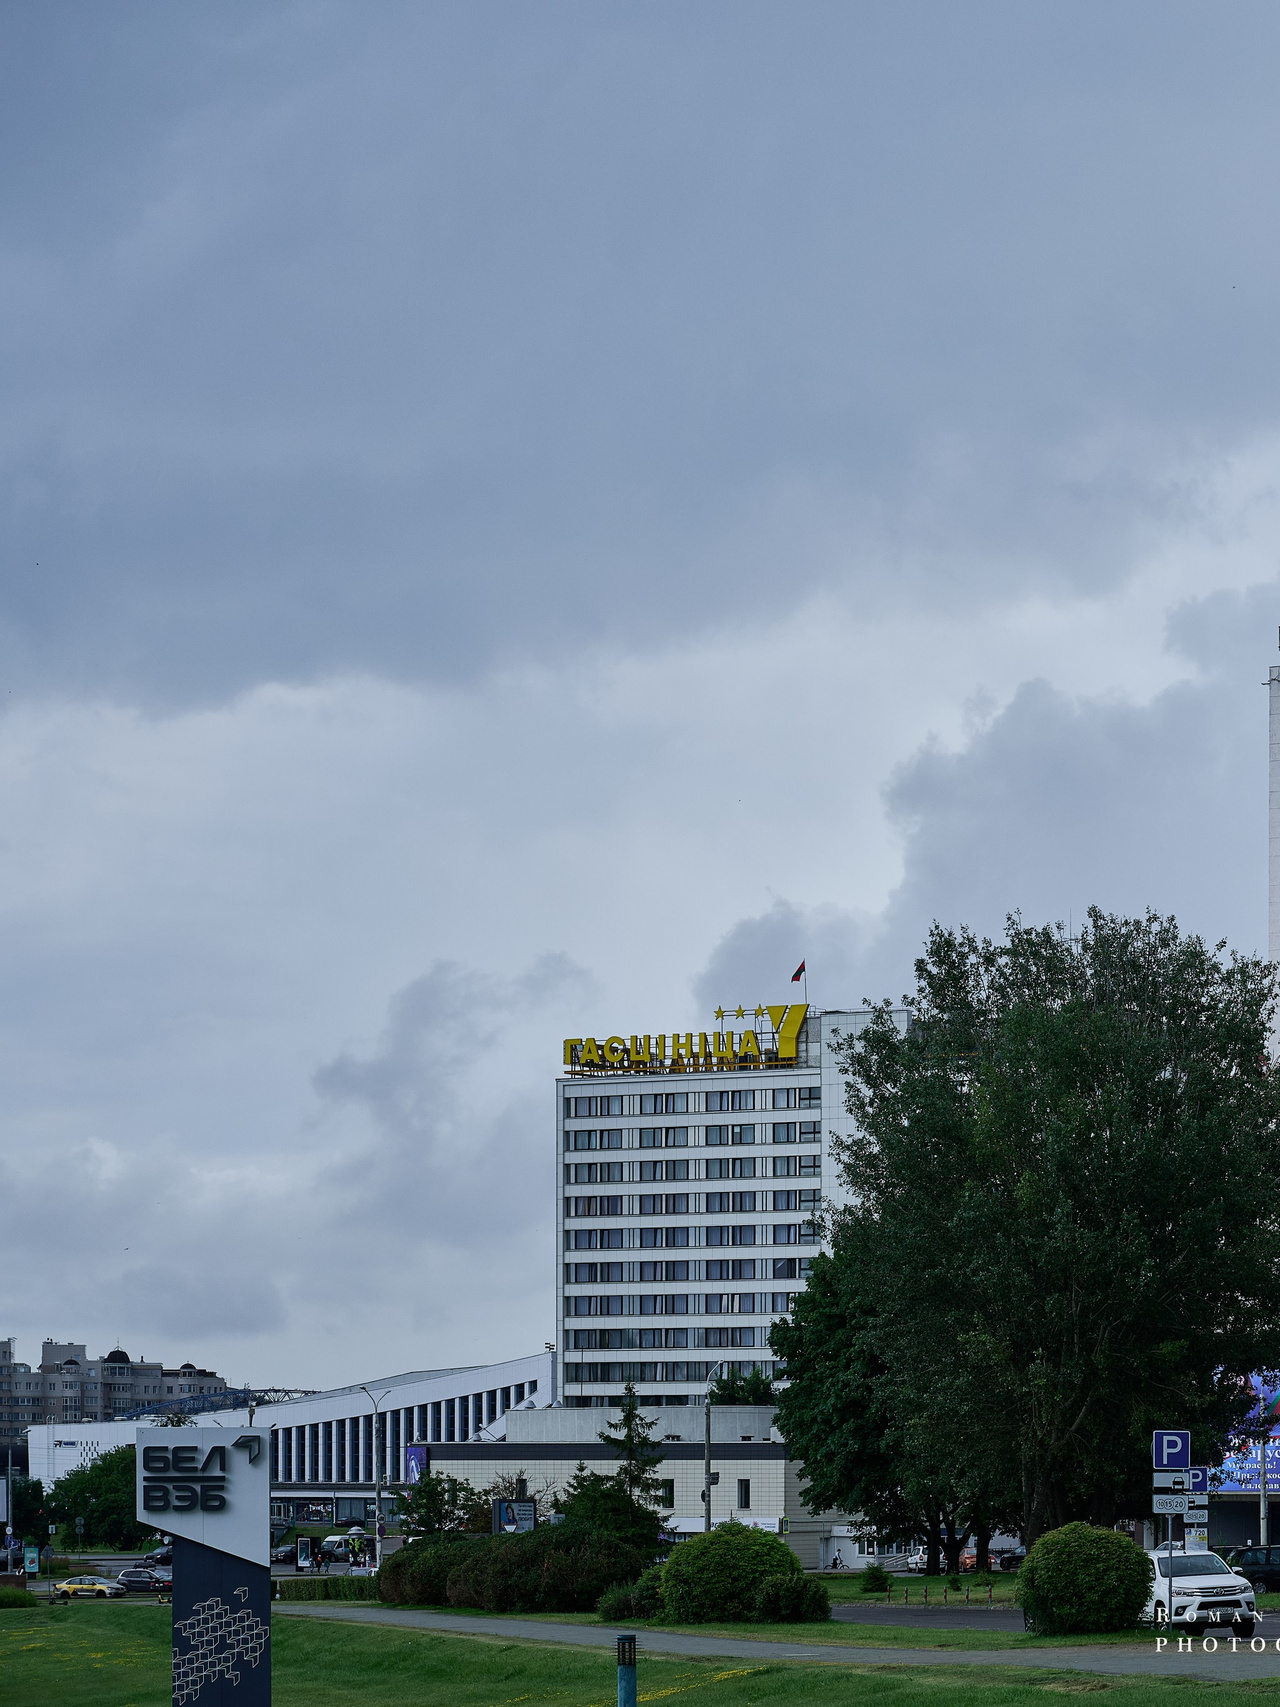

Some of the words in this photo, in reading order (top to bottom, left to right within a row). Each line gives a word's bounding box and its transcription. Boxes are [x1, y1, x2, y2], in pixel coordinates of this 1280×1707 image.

[563, 1030, 760, 1065] ГАСЦІНІЦА
[143, 1446, 226, 1472] БЕЛ
[1163, 1435, 1182, 1465] P
[1190, 1470, 1202, 1490] P
[143, 1485, 226, 1511] ВЭБ
